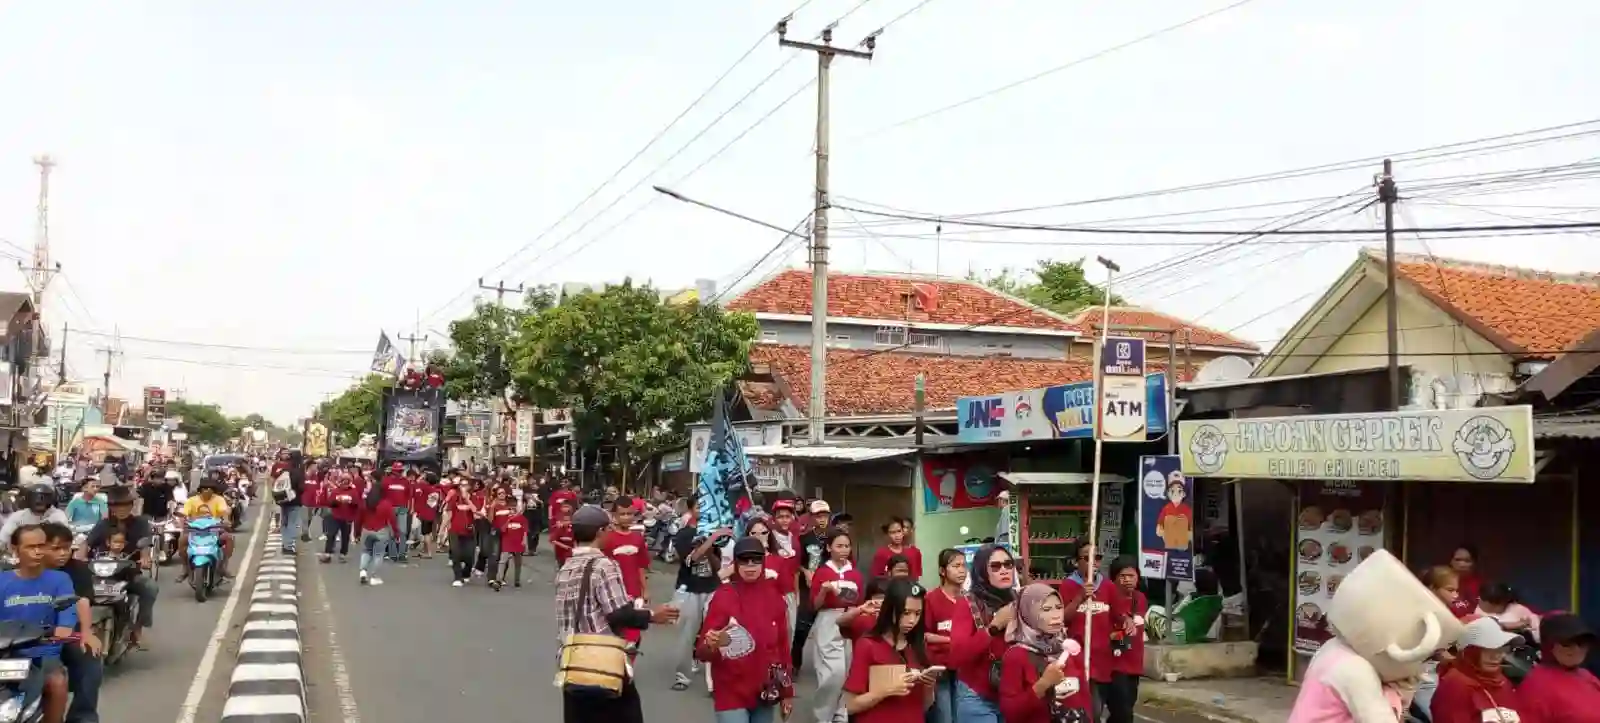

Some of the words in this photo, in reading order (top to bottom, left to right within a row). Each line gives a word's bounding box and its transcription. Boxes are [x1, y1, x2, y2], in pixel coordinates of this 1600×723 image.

[965, 398, 1005, 429] JNE
[1105, 401, 1142, 416] ATM
[1234, 420, 1327, 453] JAGOAN
[1330, 415, 1443, 452] GEPREK
[1325, 459, 1400, 478] CHICKEN
